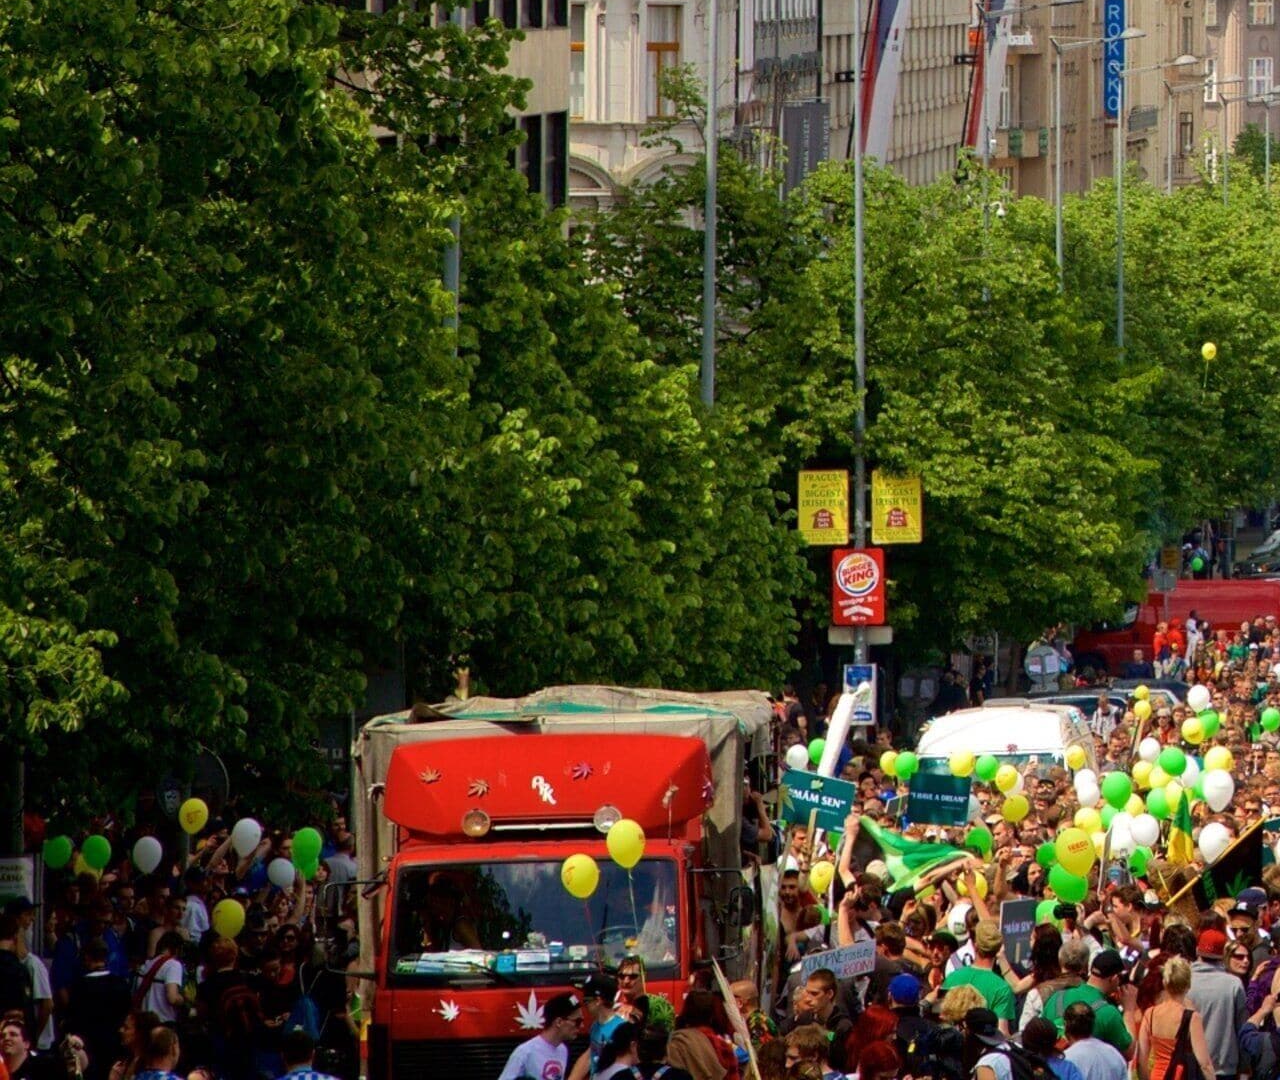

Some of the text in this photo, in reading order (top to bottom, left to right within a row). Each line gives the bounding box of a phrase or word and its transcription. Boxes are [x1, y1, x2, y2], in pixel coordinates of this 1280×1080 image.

[1107, 4, 1120, 111] ROKOKO
[842, 562, 872, 578] BURGER
[844, 568, 875, 587] KING
